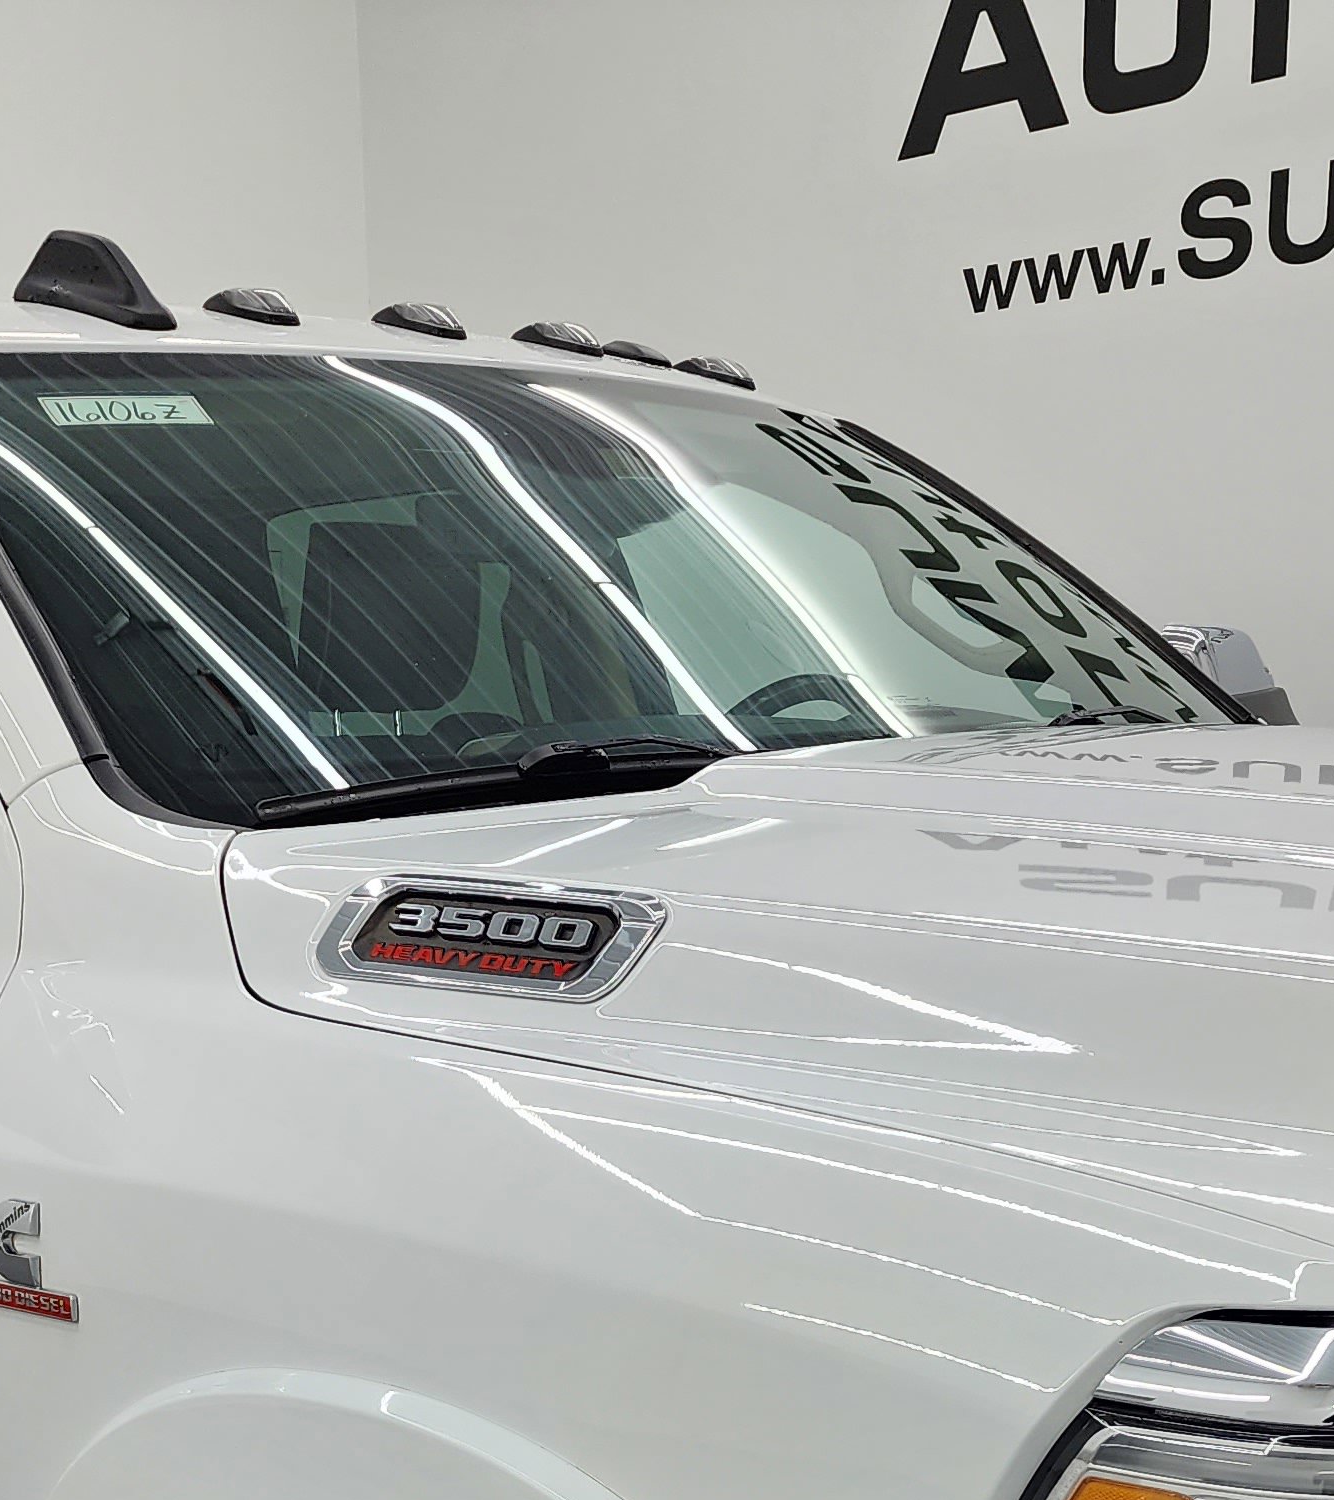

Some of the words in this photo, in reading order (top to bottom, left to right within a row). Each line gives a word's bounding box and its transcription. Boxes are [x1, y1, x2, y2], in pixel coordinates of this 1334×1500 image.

[388, 902, 597, 951] 3500
[370, 942, 483, 971] HEAVY
[478, 954, 582, 979] DUTY
[15, 1290, 70, 1315] DIESEL
